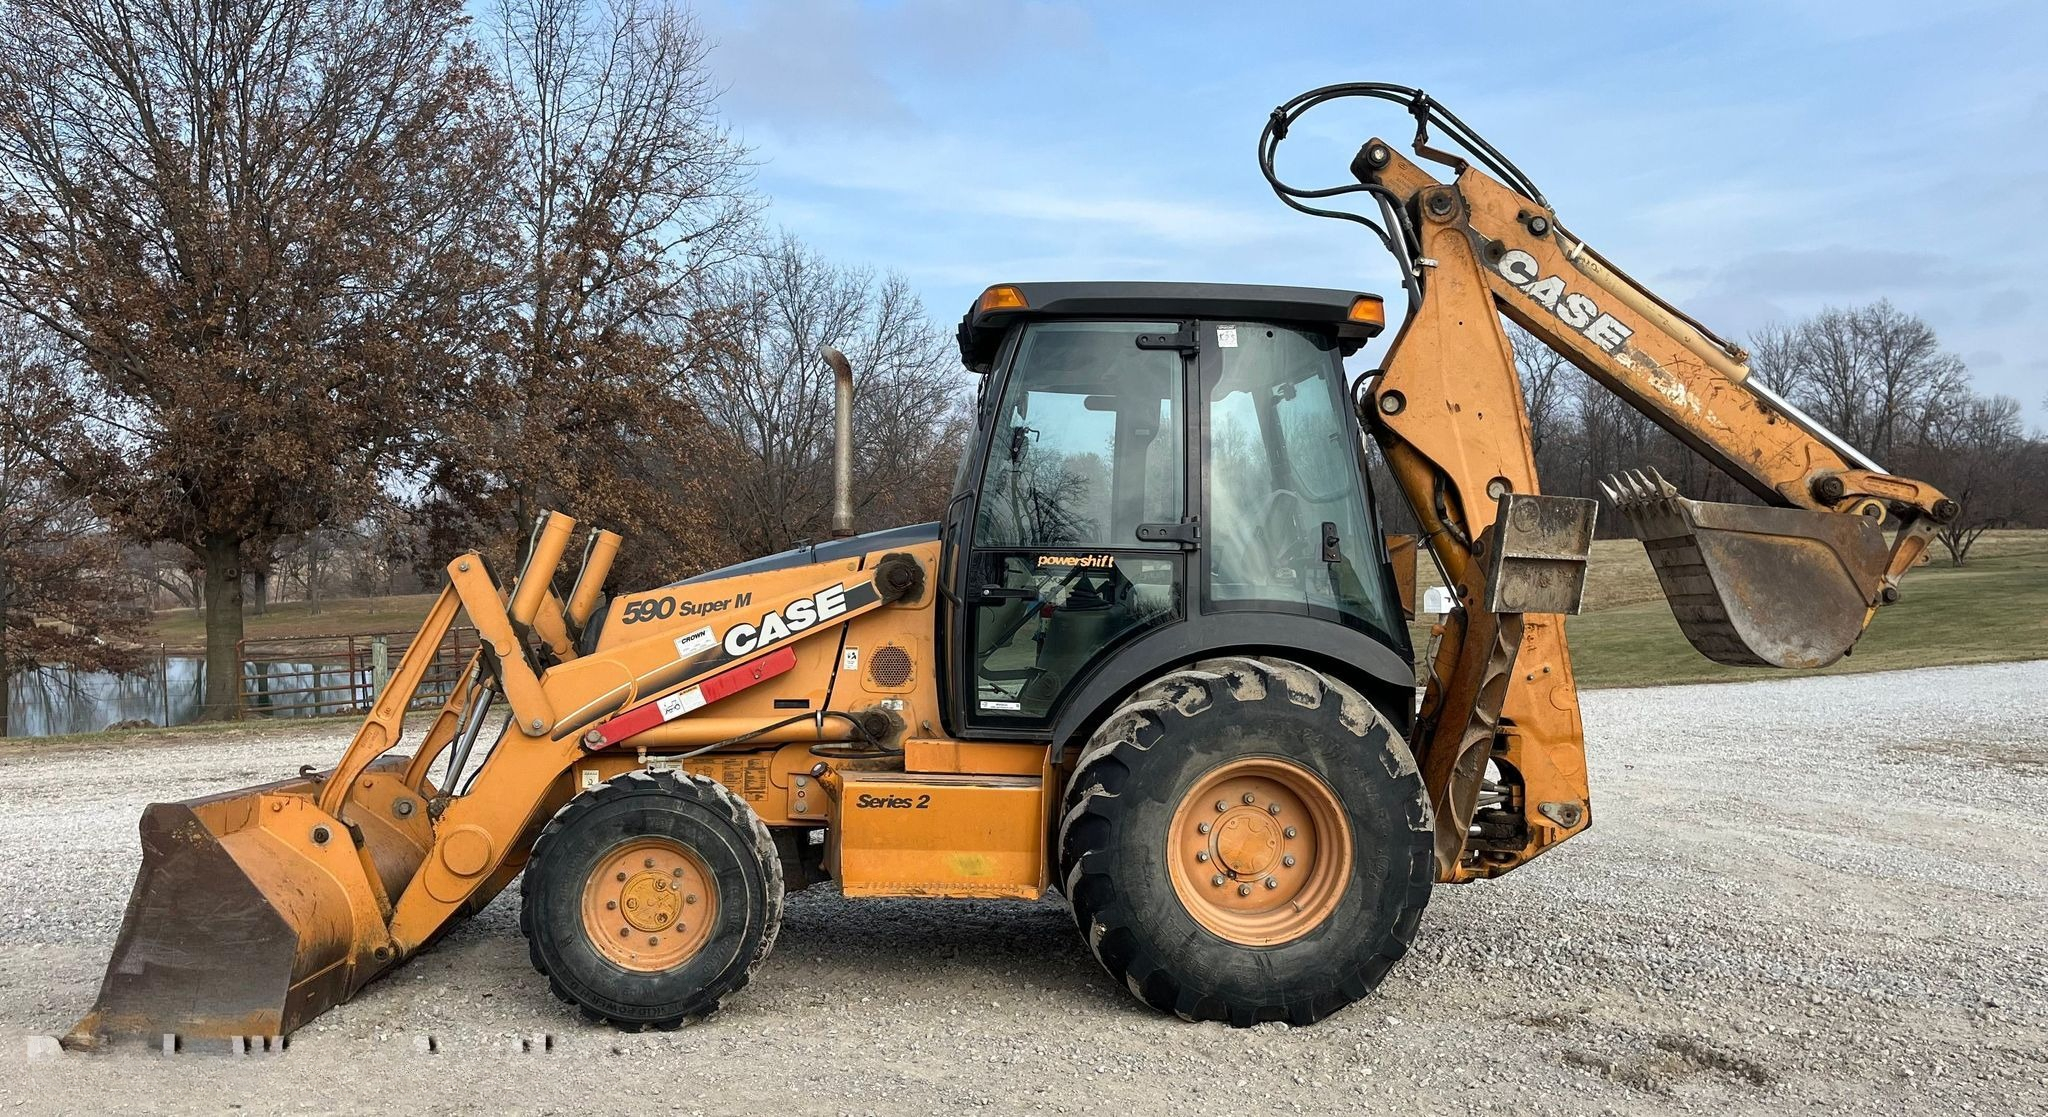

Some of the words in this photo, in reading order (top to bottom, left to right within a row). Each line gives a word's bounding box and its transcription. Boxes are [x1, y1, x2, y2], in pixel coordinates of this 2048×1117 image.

[1498, 249, 1635, 351] CASE
[1037, 554, 1115, 568] powershift
[622, 596, 676, 624] 590
[679, 600, 732, 616] Super
[735, 592, 752, 608] M
[723, 582, 847, 657] CASE
[681, 630, 706, 644] CROWN
[856, 794, 913, 808] Series
[916, 794, 931, 808] 2
